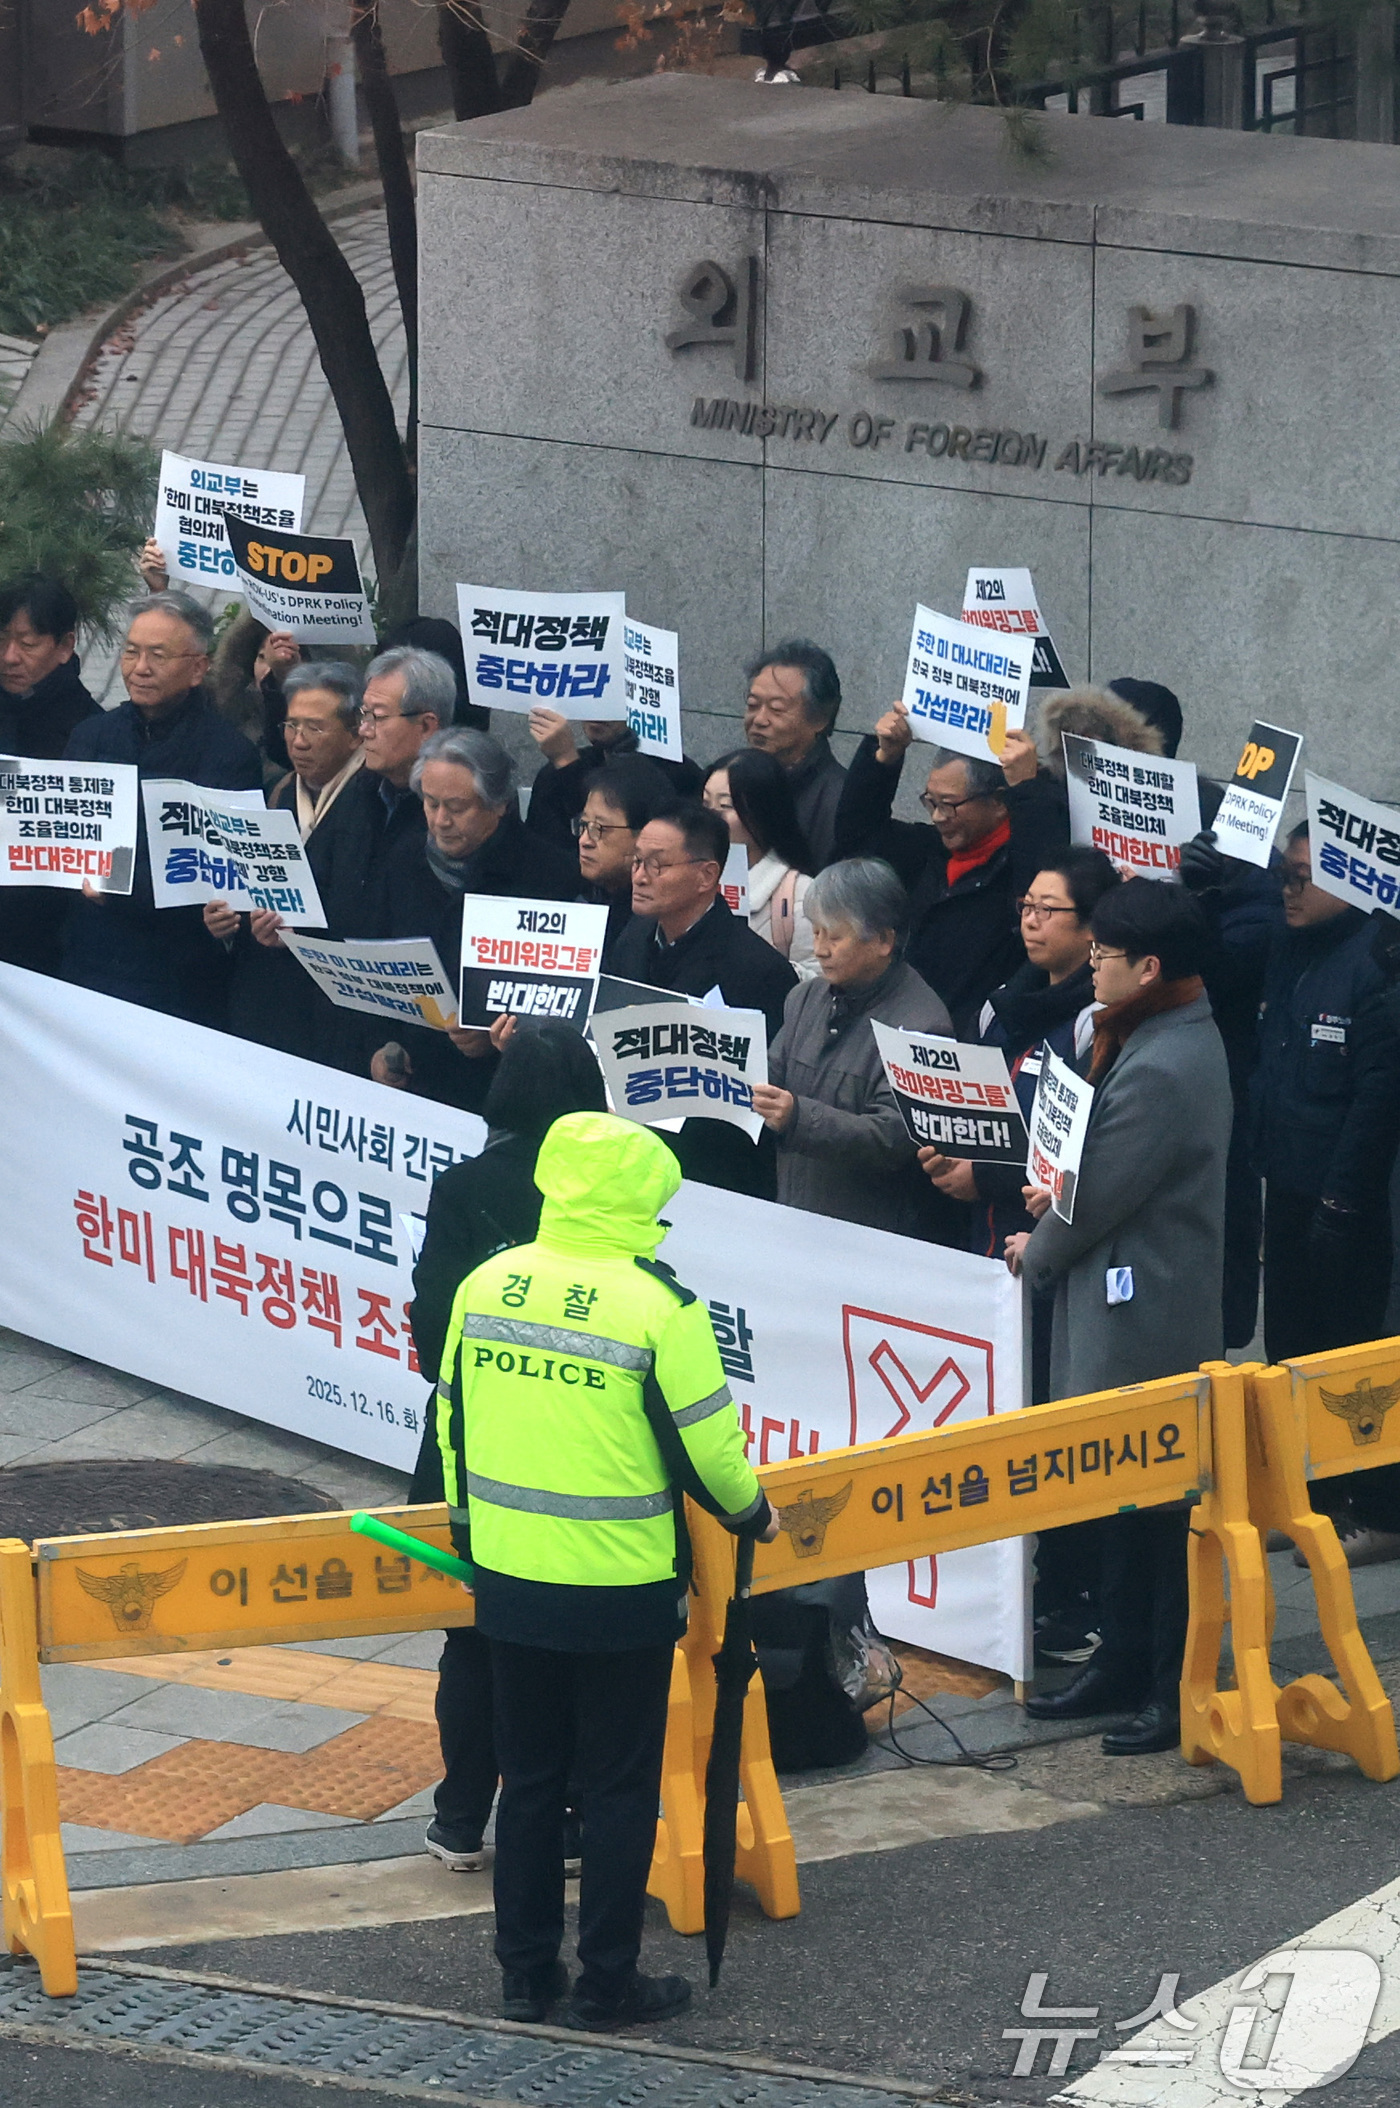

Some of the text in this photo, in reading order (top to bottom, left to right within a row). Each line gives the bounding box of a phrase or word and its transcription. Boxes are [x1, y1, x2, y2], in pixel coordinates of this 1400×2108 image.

[689, 399, 1194, 486] MINISTRY OF FOREIGN AFFAIRS
[190, 469, 258, 498] 외교부는
[247, 541, 333, 583] STOP
[288, 596, 321, 609] DPRK
[324, 599, 363, 612] Policy
[975, 579, 1005, 600] 제2의
[303, 614, 363, 627] Meeting!
[470, 608, 610, 651] 적대정책
[916, 629, 1021, 680] 주한 미 대사대리는
[476, 653, 611, 699] 중단하라
[912, 657, 1020, 706] 한국 정부 대북정책에
[639, 685, 660, 708] 강행
[911, 688, 993, 736] 간섭말라!
[0, 774, 115, 796] 대북정책 통제할
[1080, 752, 1174, 791] 대북정책 통제할
[5, 796, 112, 819] 한미 대북정책
[1088, 775, 1174, 815] 한미 대북정책
[1225, 792, 1277, 824] DPRK Policy
[19, 820, 102, 841] 조율협의체
[1098, 802, 1166, 836] 조율협의체
[1227, 813, 1269, 842] Meeting!
[253, 865, 288, 882] 강행
[516, 910, 567, 935] 제2의
[347, 957, 434, 977] 대사대리는
[471, 935, 598, 972] '한미워킹그룹'
[485, 980, 582, 1019] 반대한다!
[612, 1023, 751, 1072] 적대정책
[909, 1044, 961, 1072] 제2의
[887, 1061, 1011, 1108] '한미워킹그룹'
[286, 1097, 394, 1171] 시민사회
[911, 1107, 1011, 1149] 반대한다!
[122, 1113, 209, 1203] 공조
[221, 1145, 399, 1267] 명목으로
[73, 1188, 156, 1284] 한미
[168, 1224, 342, 1349] 대북정책
[474, 1346, 606, 1391] POLICE
[871, 1423, 1186, 1523] 이 선을 넘지마시오
[209, 1567, 249, 1607] 이
[269, 1557, 353, 1602] 선을
